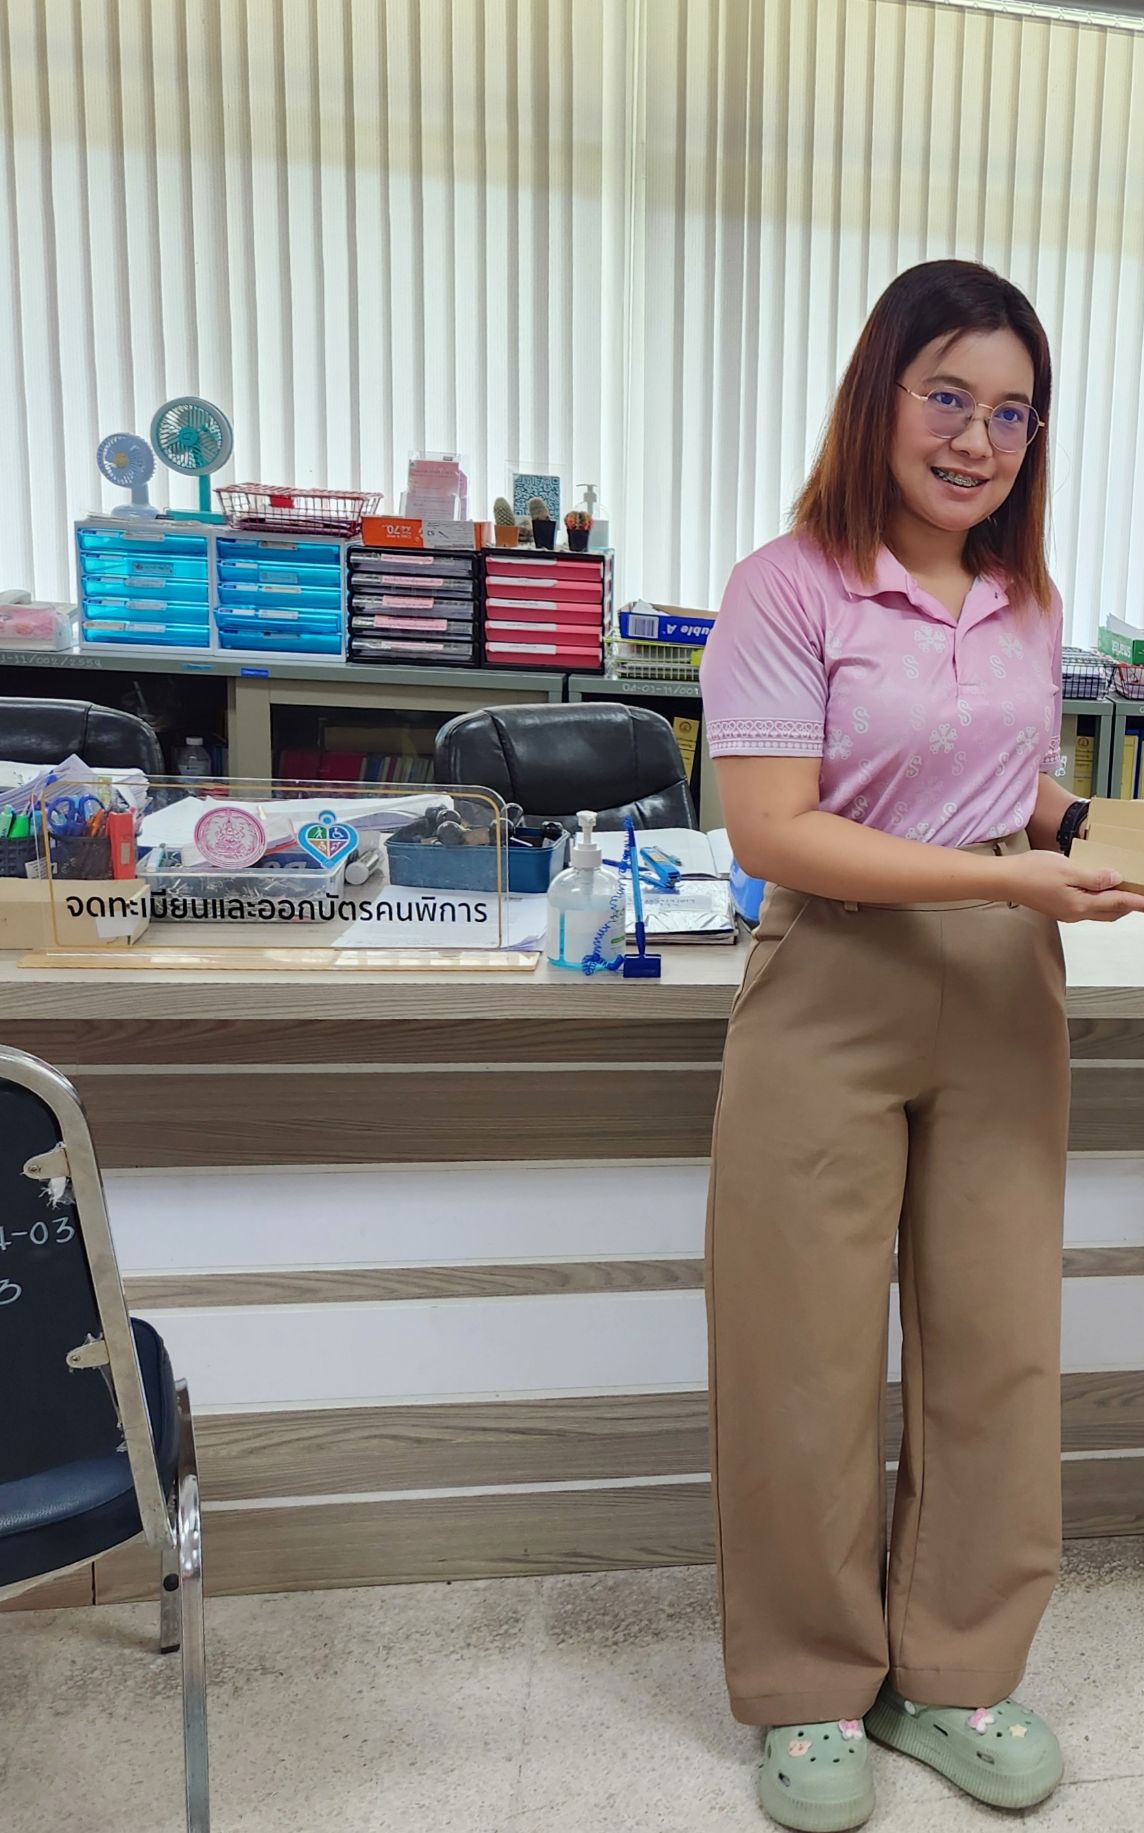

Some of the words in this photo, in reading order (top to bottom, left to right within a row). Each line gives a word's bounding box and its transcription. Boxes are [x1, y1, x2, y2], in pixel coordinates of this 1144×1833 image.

[666, 623, 677, 635] A
[66, 893, 488, 923] จดทะเบียนและออกบัตรคนพิการ
